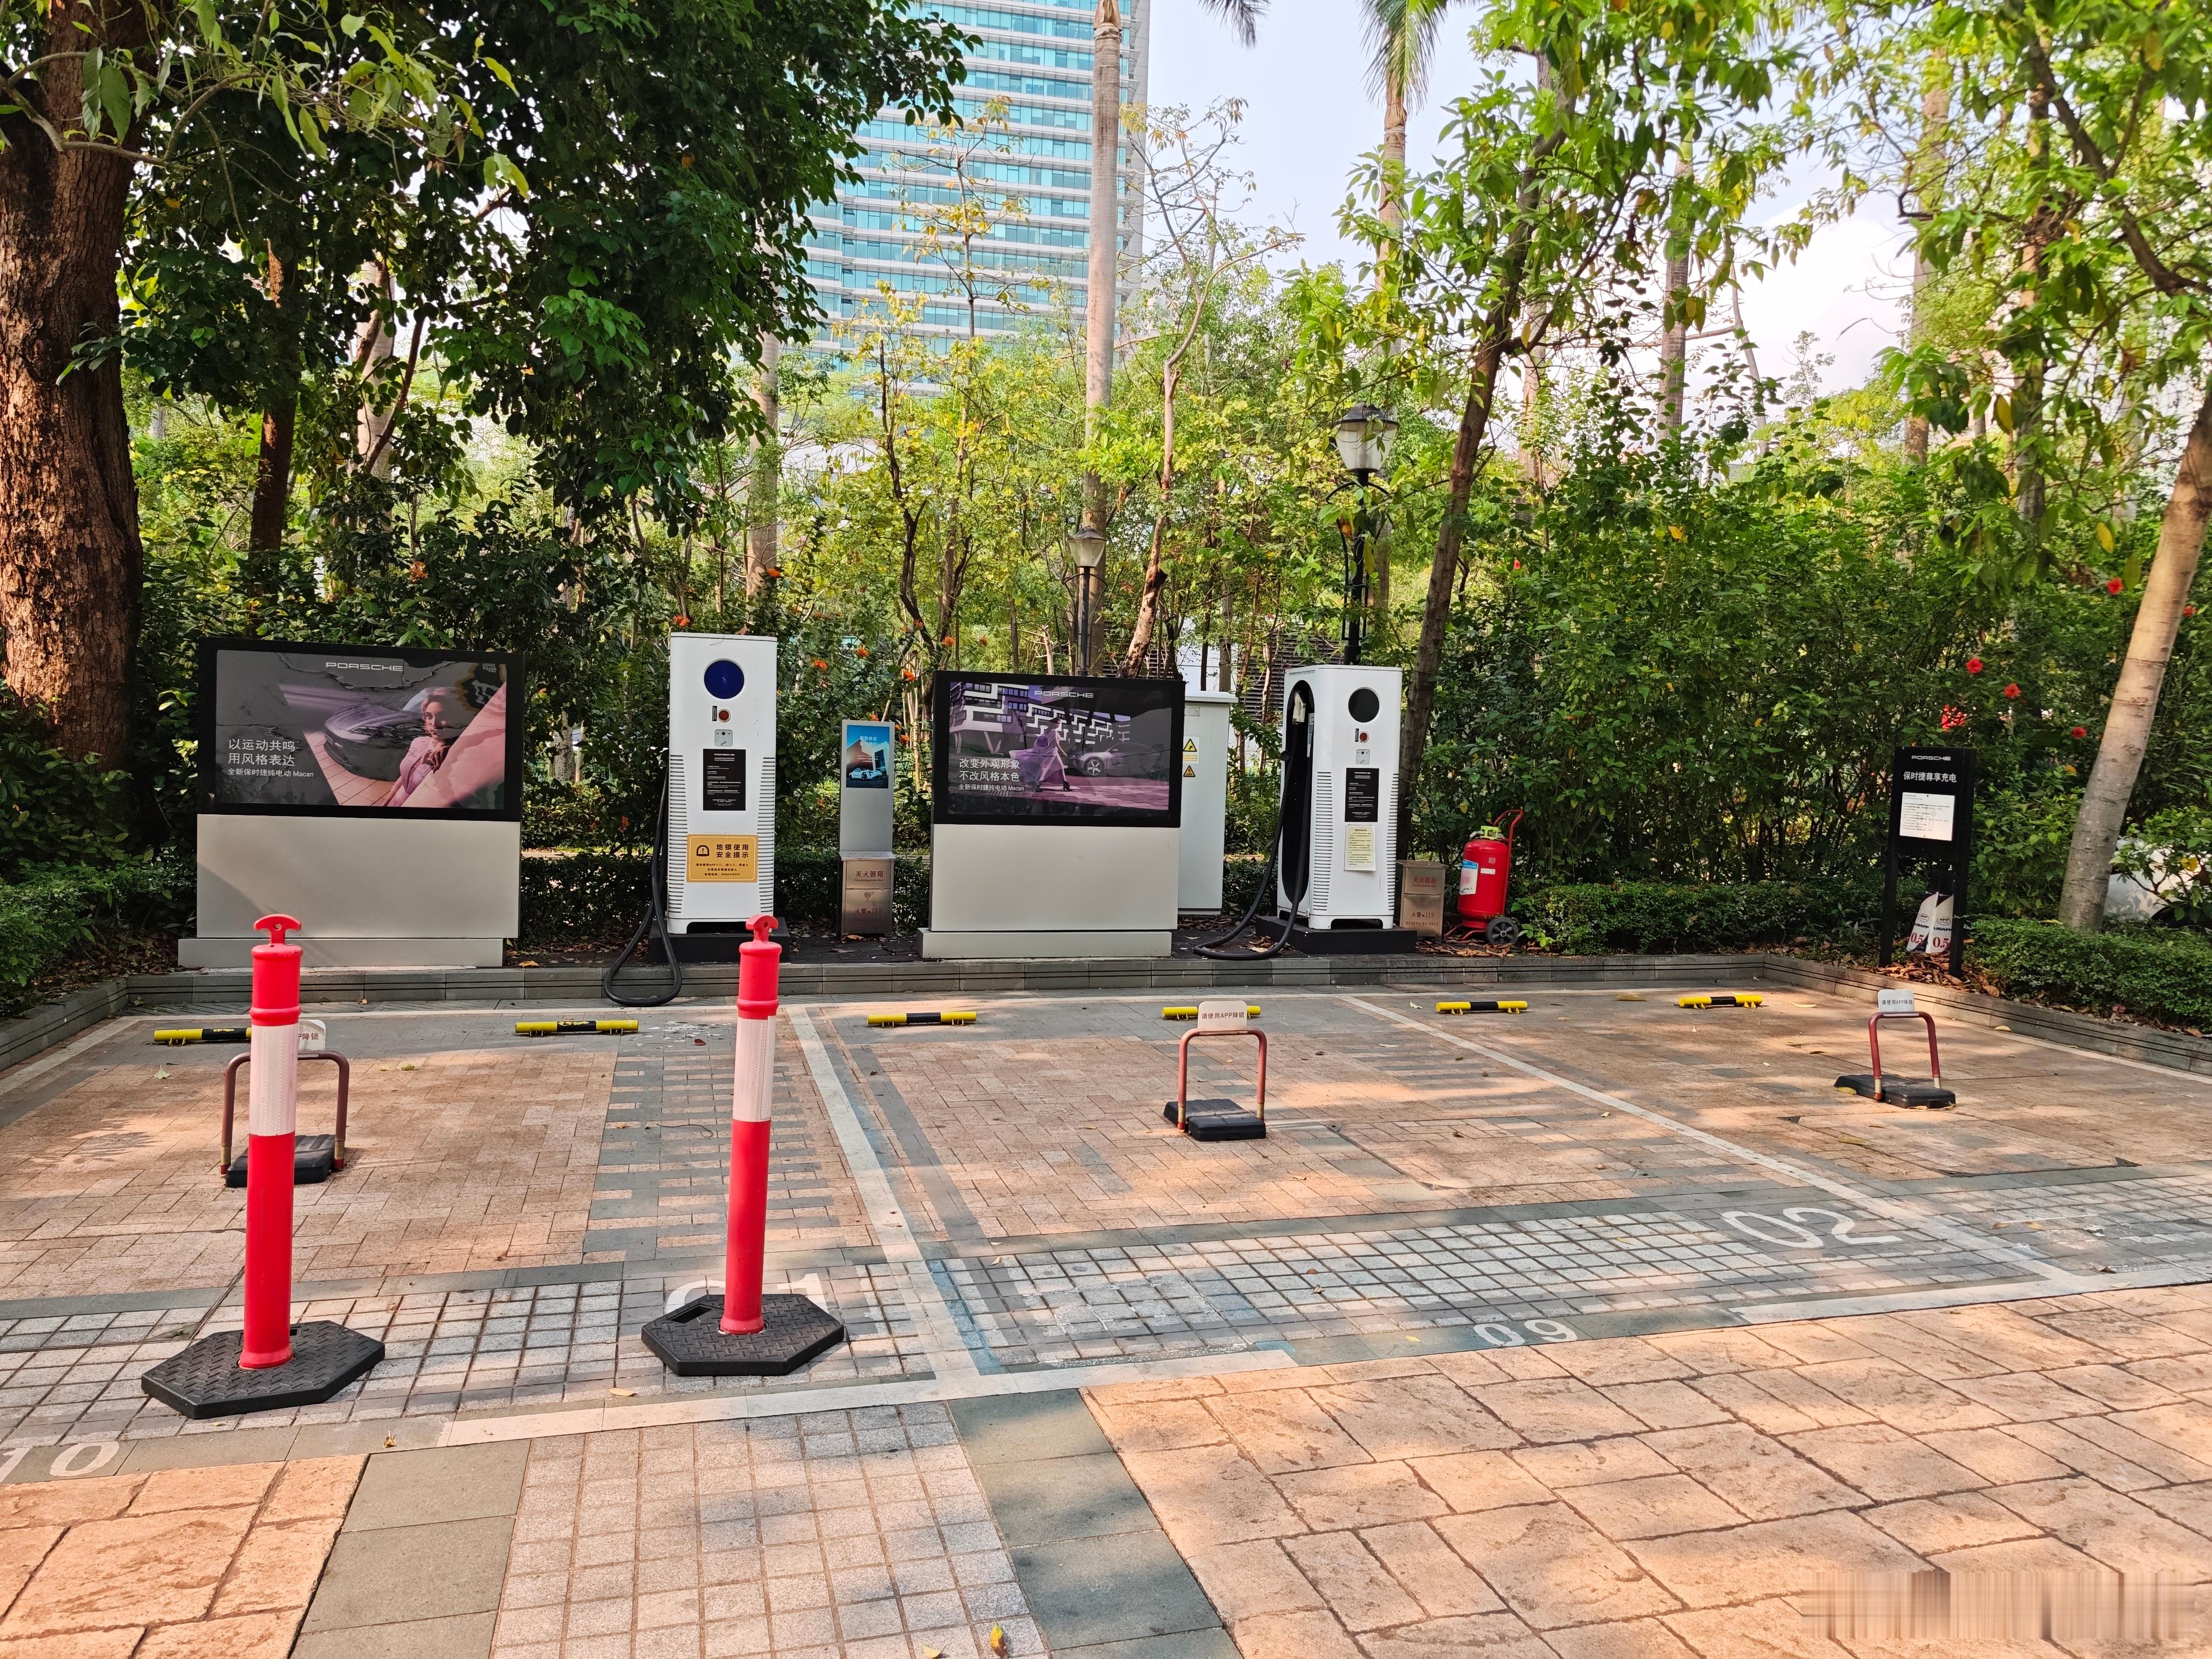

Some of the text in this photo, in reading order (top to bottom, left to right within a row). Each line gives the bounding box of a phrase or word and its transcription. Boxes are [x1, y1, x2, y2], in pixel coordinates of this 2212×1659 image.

[326, 662, 403, 671] PORSCHE
[228, 739, 296, 752] 以运动共鸣
[228, 752, 295, 766] 用风格表达
[959, 758, 1020, 769] 改变外观形象
[227, 768, 291, 777] 全新保时捷纯电动
[959, 771, 1020, 781] 不改风格本色
[1903, 771, 1957, 783] 保时捷尊享充电
[1721, 1207, 1903, 1249] 02
[1473, 1319, 1578, 1347] 09
